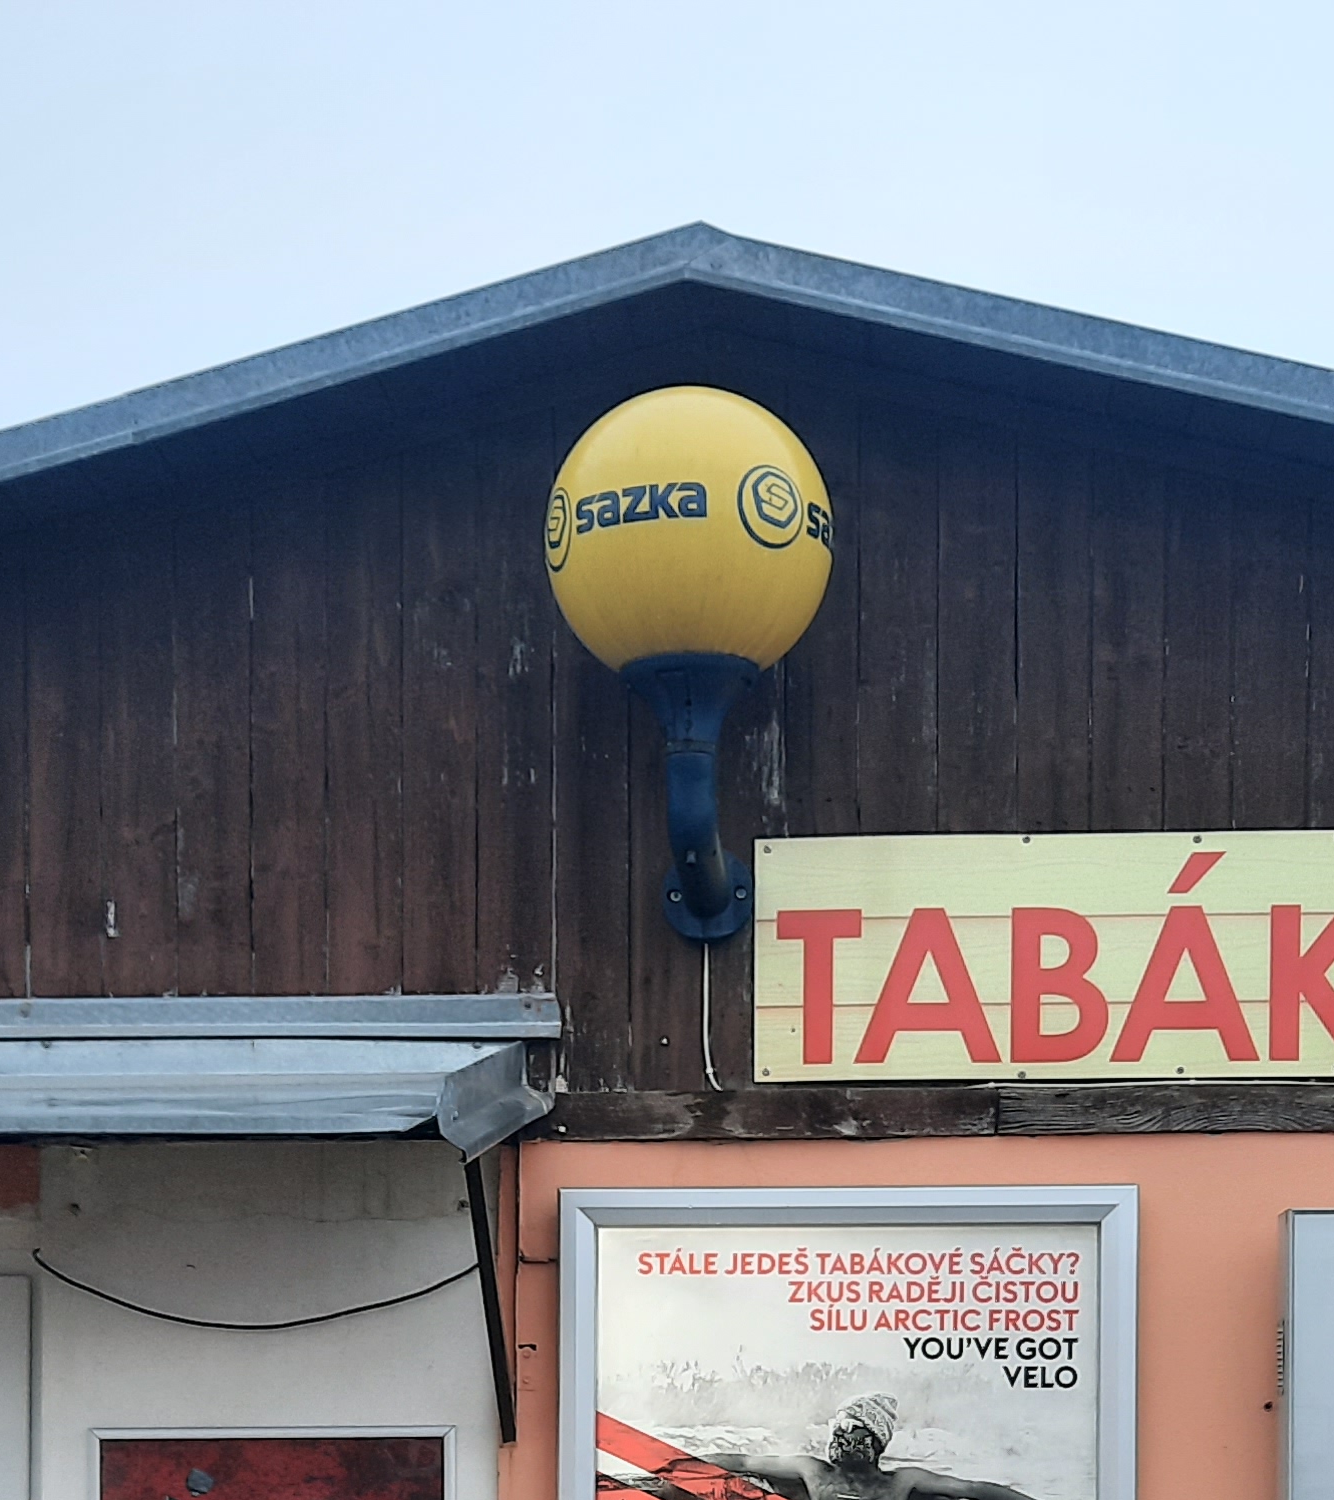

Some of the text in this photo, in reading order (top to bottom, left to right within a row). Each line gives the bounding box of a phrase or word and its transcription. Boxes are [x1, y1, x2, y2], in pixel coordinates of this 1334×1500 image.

[638, 1247, 1080, 1277] STÁLE JEDEŠ TABÁKOVÉ SÁČKY?
[788, 1275, 1079, 1304] ZKUS RADĚJI ČISTOU
[809, 1304, 1079, 1332] SÍLU ARCTIC FROST
[903, 1337, 1078, 1361] YOU'VE GOT
[1003, 1366, 1078, 1389] VELO
